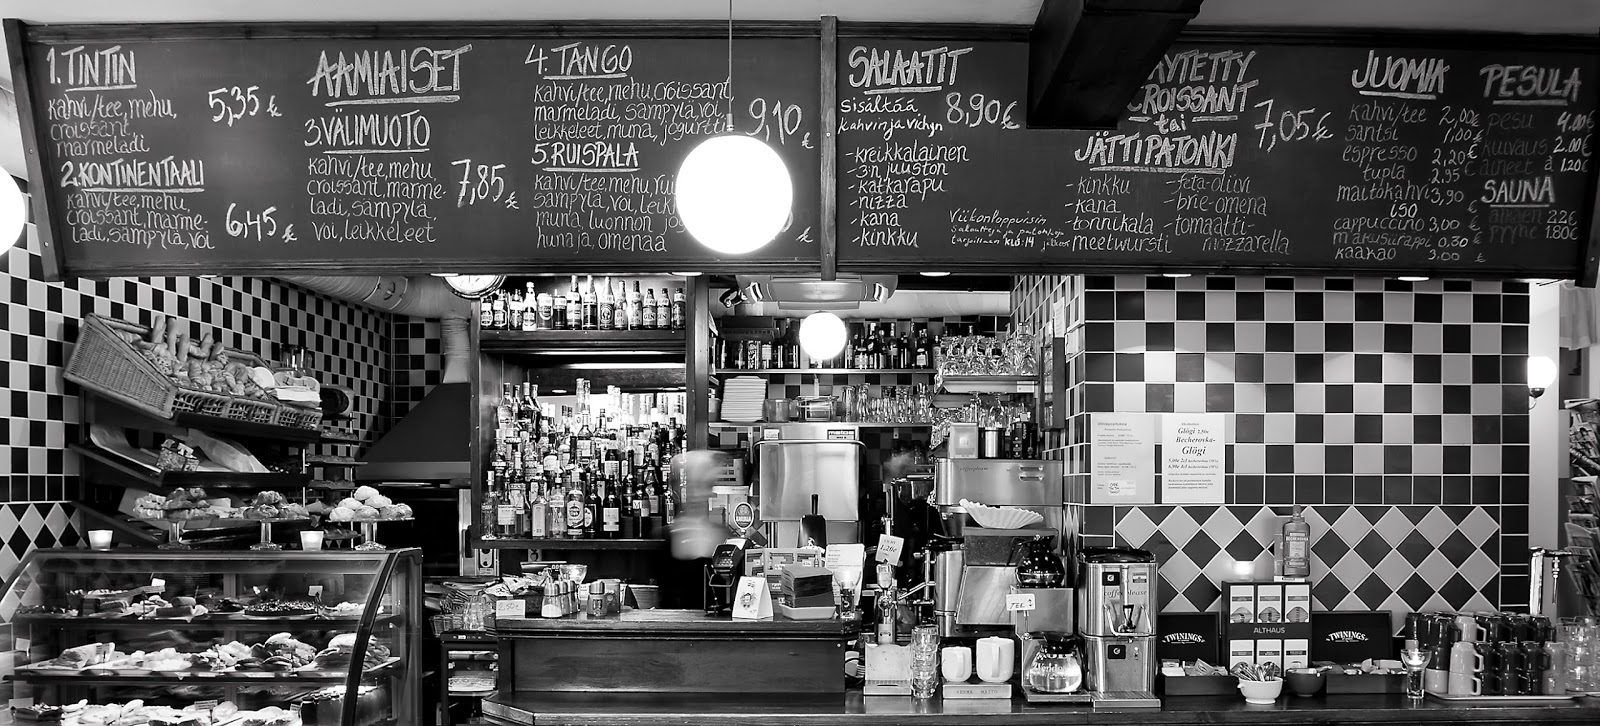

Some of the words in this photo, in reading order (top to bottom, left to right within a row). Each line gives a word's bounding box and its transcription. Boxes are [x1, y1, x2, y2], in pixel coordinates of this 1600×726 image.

[61, 45, 136, 86] TINTIN
[551, 41, 633, 75] TANGO
[849, 46, 973, 88] SALAATIT
[306, 43, 473, 98] AAMIAISET
[1352, 50, 1450, 94] JUOMIA
[1480, 64, 1582, 102] PESULA
[129, 90, 177, 119] mehu,
[208, 85, 260, 127] 5,35
[1349, 100, 1427, 127] kahvi/tee
[745, 98, 801, 145] 9,10
[1154, 113, 1185, 134] tai
[1345, 124, 1399, 142] santsi
[1487, 112, 1534, 136] pesu
[1075, 130, 1237, 168] JÄTTIPATONKI
[1343, 144, 1418, 168] espresso
[884, 160, 949, 181] juuston
[1363, 163, 1405, 187] tupla
[451, 158, 506, 208] 7,85
[1337, 180, 1430, 202] maitokahvi
[1430, 187, 1464, 206] 3,90
[1481, 176, 1556, 204] SAUNA
[589, 211, 653, 231] luonnon
[1390, 199, 1418, 219] iso
[225, 203, 277, 241] 6,45
[344, 218, 436, 243] leikkeleet
[1333, 216, 1424, 233] cappuccino
[1429, 216, 1460, 234] 3,00
[188, 233, 215, 249] voi
[599, 231, 667, 252] omenaa
[1072, 233, 1172, 254] meetwursti
[1202, 230, 1291, 255] mozzarella
[1335, 246, 1396, 261] kaakao
[1177, 427, 1196, 436] Glögi
[1181, 446, 1206, 456] Glögi
[1163, 631, 1204, 644] TWININGS
[1253, 626, 1286, 634] ALTHAUS
[1327, 629, 1368, 642] TWININGS
